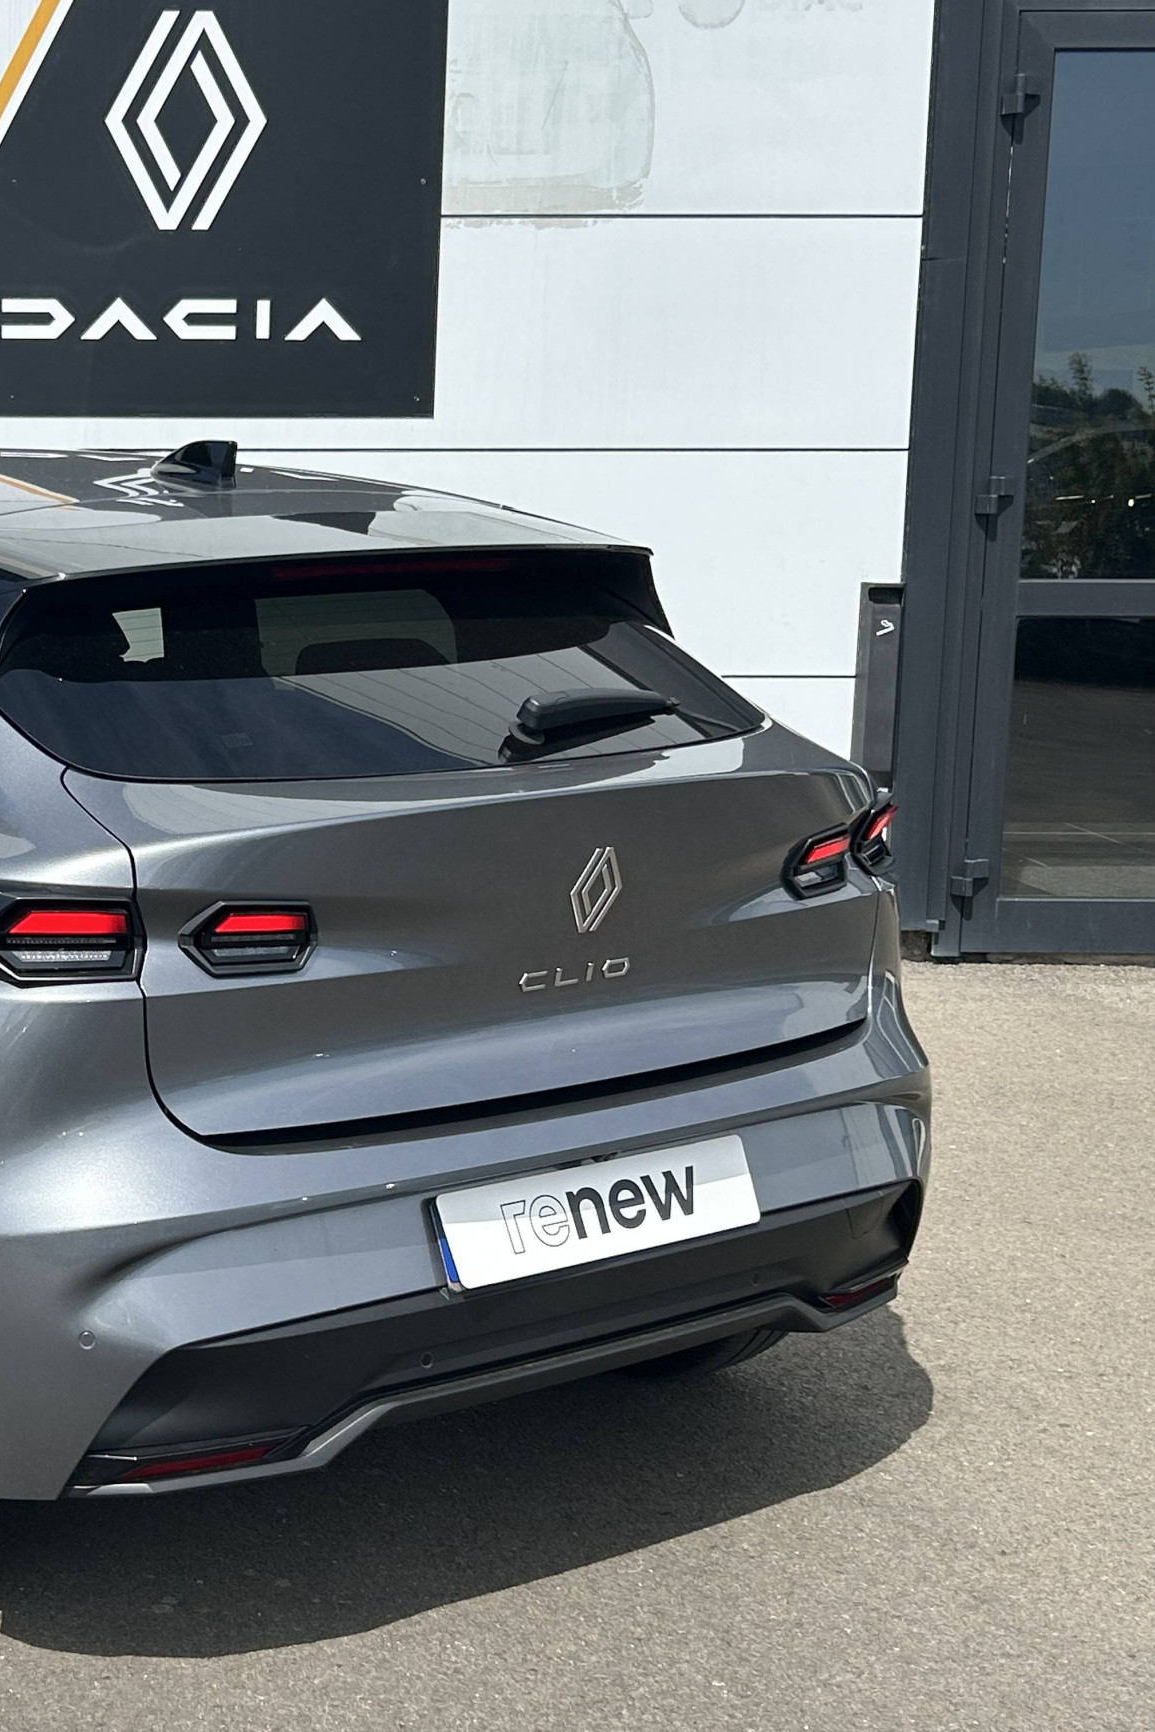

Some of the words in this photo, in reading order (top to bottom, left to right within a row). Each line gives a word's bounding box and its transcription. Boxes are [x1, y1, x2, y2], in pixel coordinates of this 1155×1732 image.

[0, 297, 362, 341] DACIA
[518, 957, 630, 992] CLIO
[499, 1165, 694, 1254] renew
